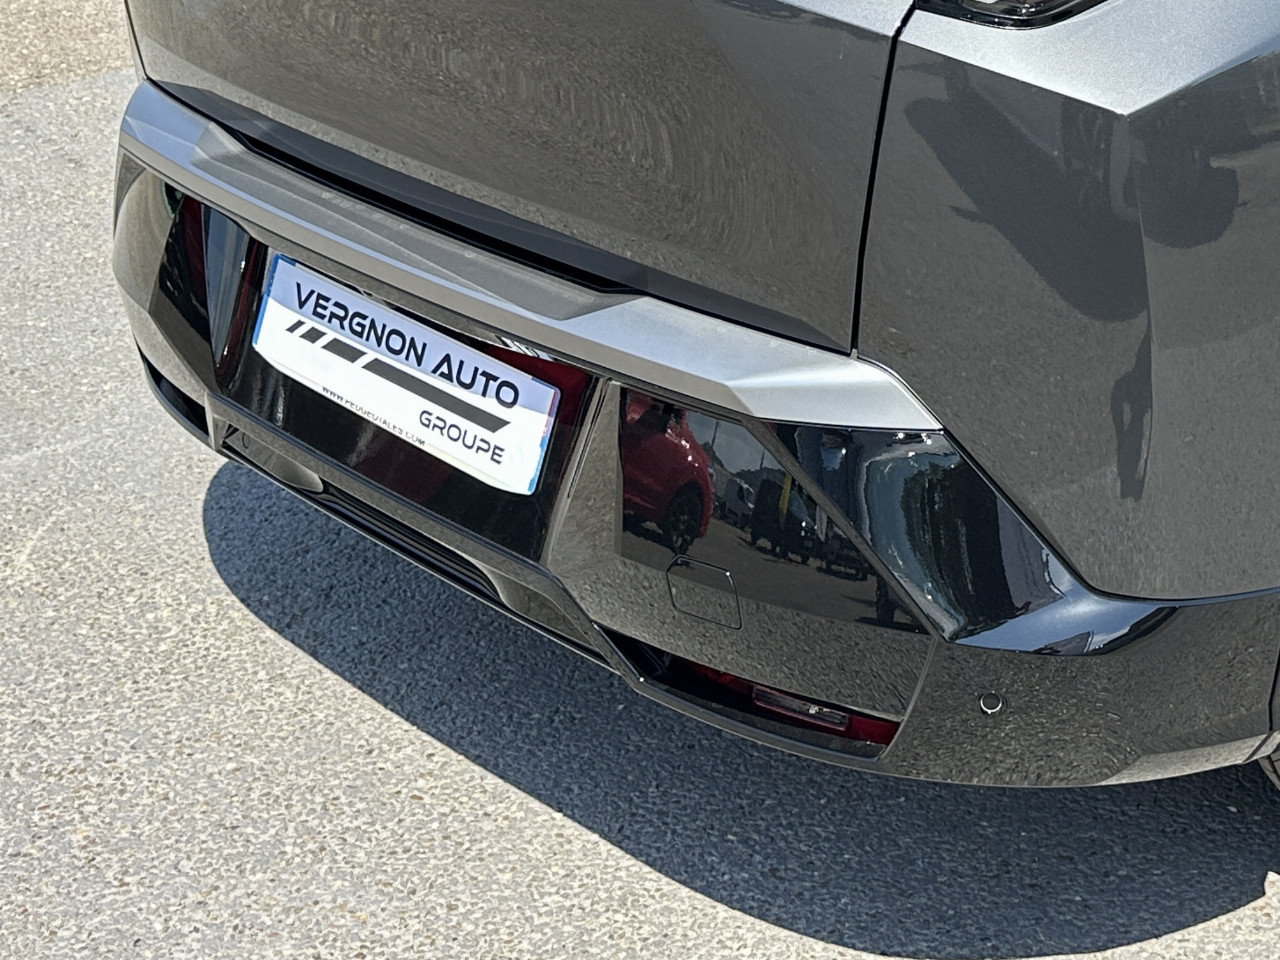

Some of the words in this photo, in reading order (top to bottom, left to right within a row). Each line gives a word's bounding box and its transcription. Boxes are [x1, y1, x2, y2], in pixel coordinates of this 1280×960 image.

[296, 281, 428, 368] VERGNON
[431, 353, 519, 409] AUTO
[418, 410, 506, 465] GROUPE
